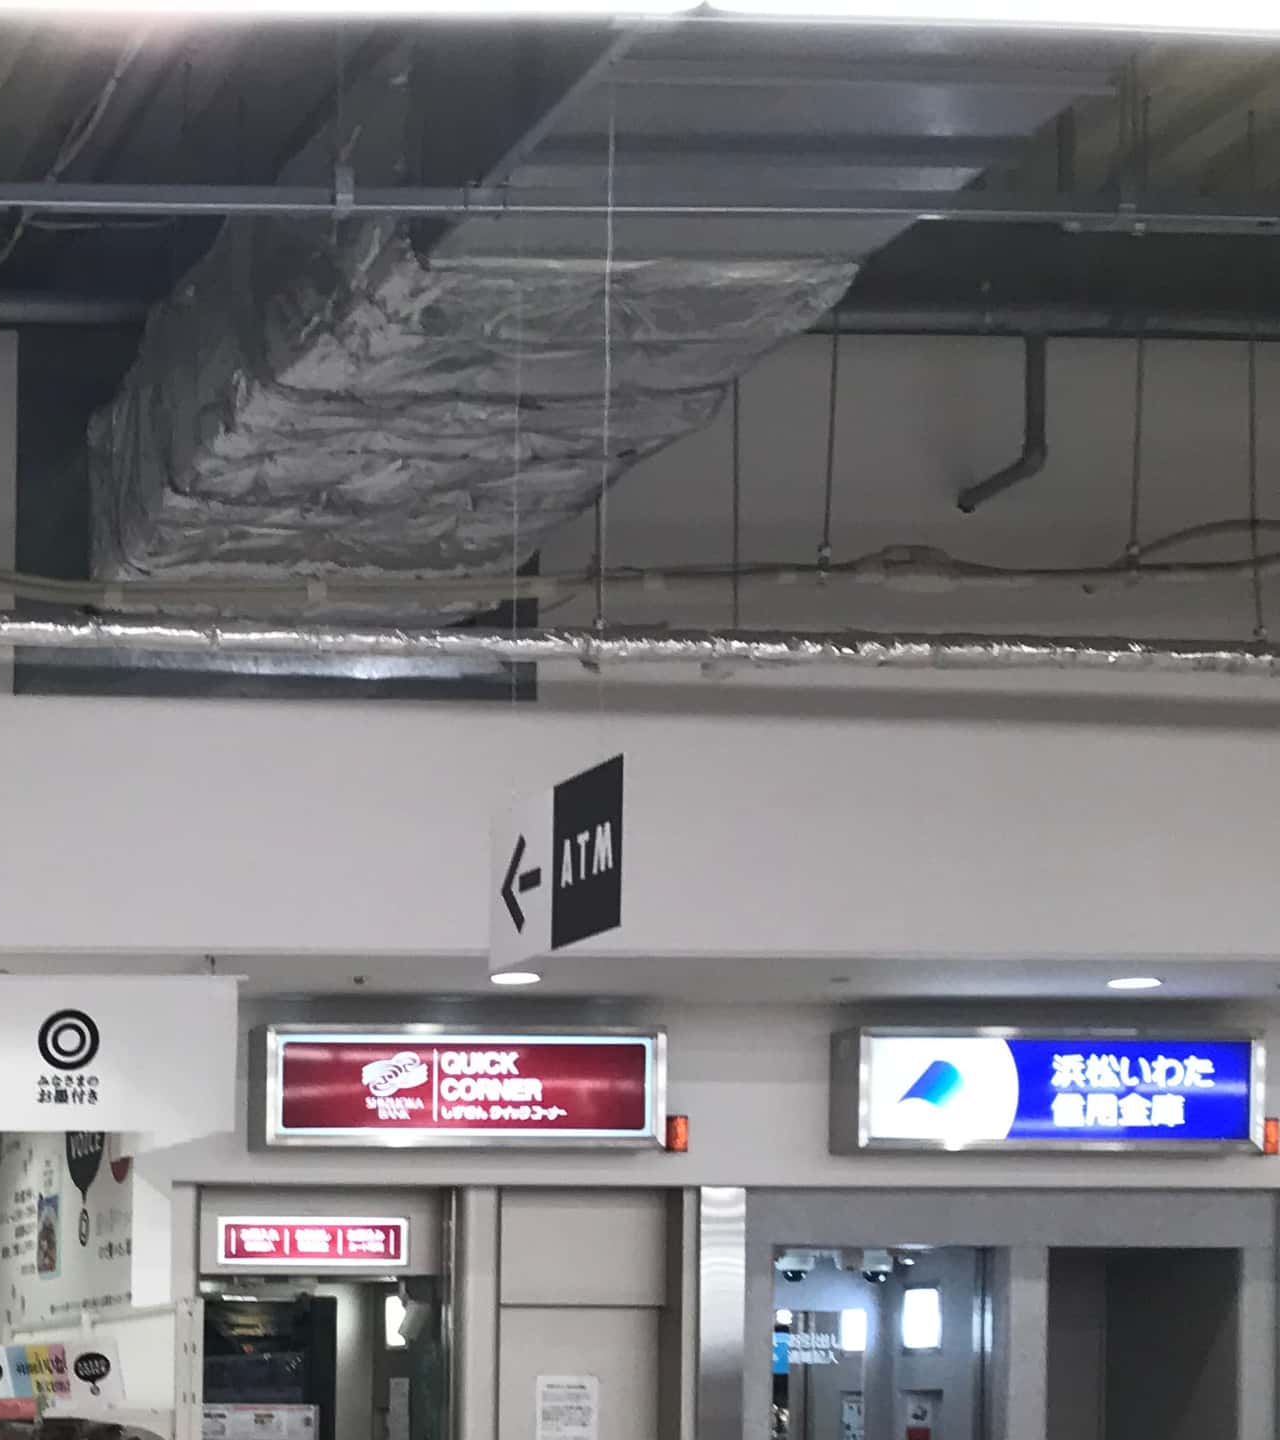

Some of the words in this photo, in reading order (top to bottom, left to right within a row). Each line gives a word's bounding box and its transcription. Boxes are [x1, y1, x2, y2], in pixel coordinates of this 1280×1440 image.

[561, 821, 614, 888] ATM
[440, 1051, 519, 1075] QUICK
[1051, 1055, 1215, 1090] 浜松いわた
[37, 1090, 100, 1106] お墨付き
[440, 1078, 543, 1101] CORNER
[1051, 1094, 1186, 1127] 信用金庫
